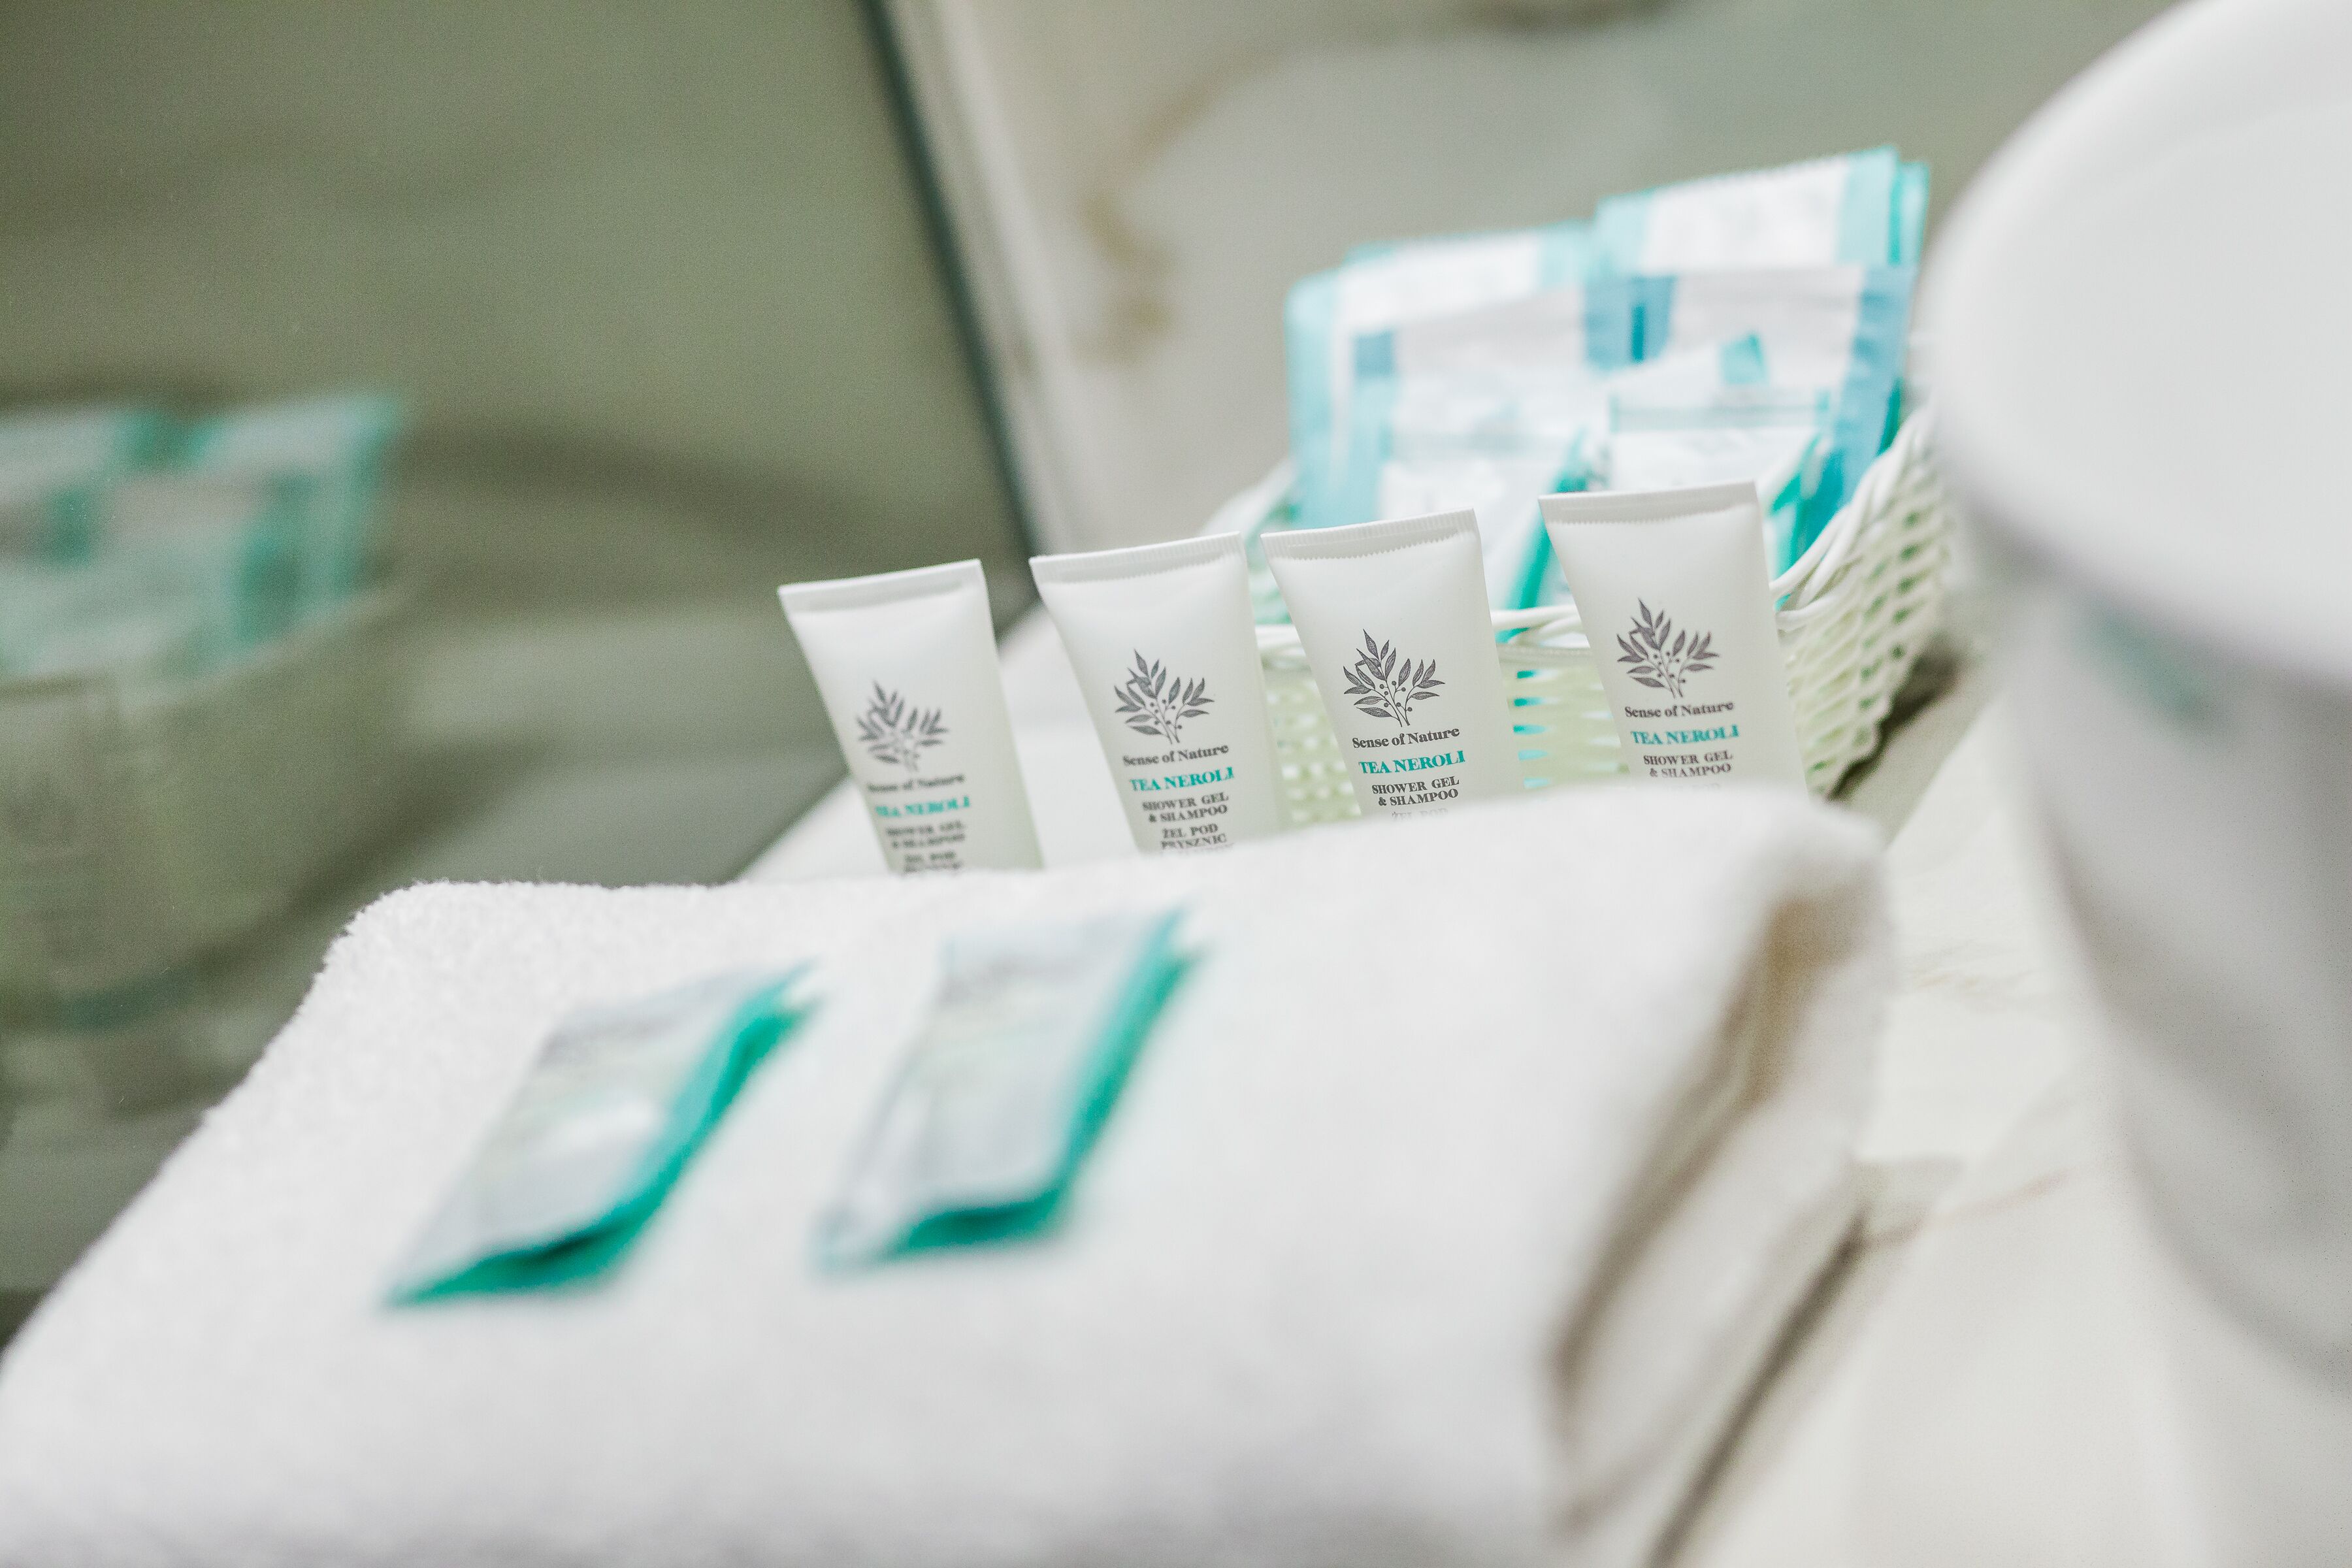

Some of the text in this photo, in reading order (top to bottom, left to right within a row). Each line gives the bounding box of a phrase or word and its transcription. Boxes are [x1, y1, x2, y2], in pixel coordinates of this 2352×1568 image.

[1625, 700, 1735, 718] Sense of Nature
[1352, 728, 1460, 749] Sense of Nature
[1631, 724, 1740, 745] TEA NEROLI
[1122, 744, 1230, 766] Sense of Nature
[1358, 750, 1465, 774] TEA NEROLI
[1643, 750, 1733, 766] SHOWER GEL
[1130, 766, 1234, 791] TEA NEROLI
[1649, 763, 1731, 778] & SHAMPOO
[1372, 776, 1460, 794] SHOWER GEL
[1142, 792, 1229, 811] SHOWER GEL
[1378, 788, 1458, 806] & SHAMPOO
[1160, 804, 1228, 823] SHAMPOO
[1190, 823, 1218, 836] POD
